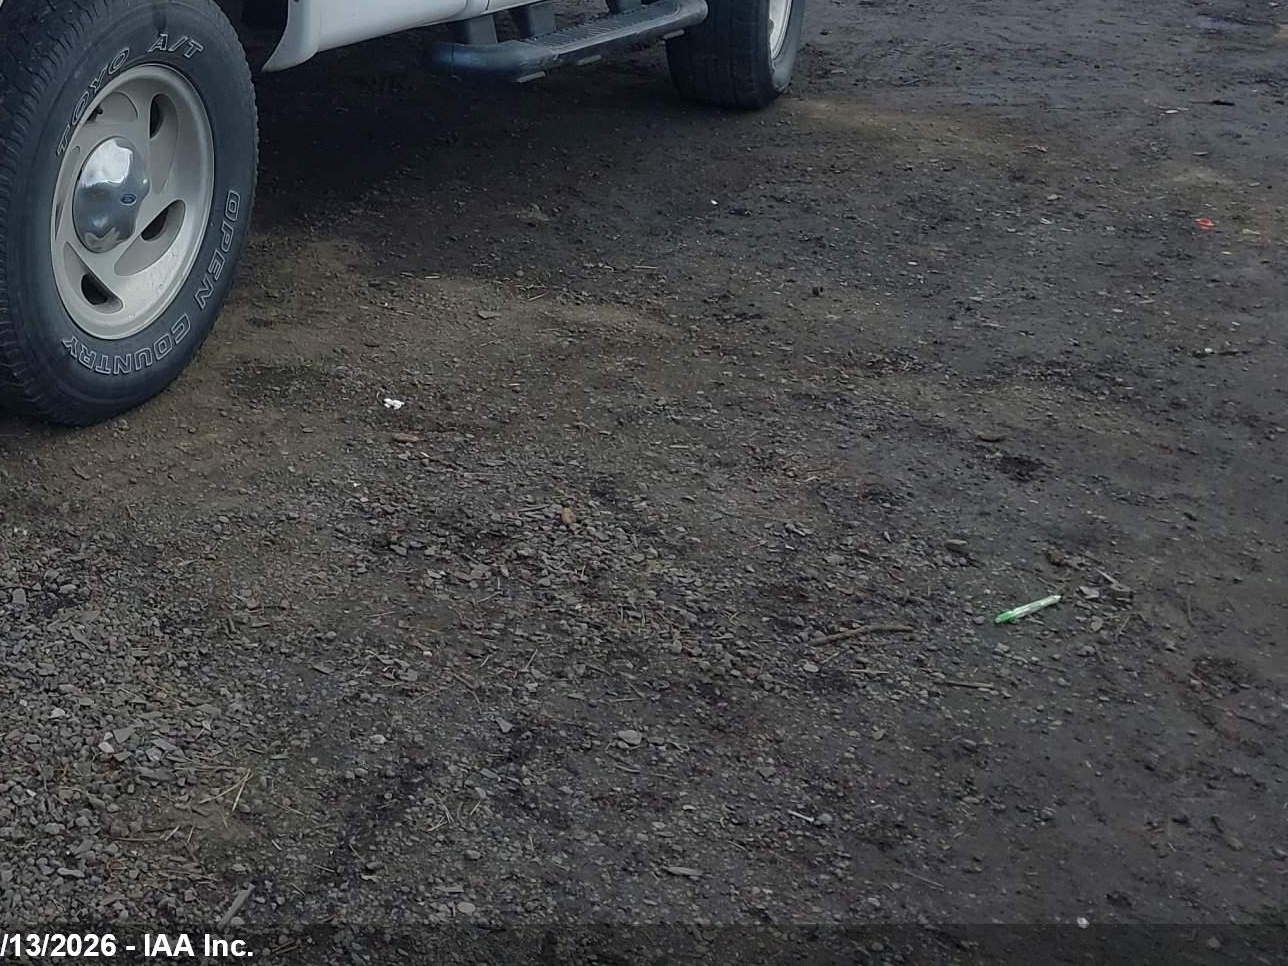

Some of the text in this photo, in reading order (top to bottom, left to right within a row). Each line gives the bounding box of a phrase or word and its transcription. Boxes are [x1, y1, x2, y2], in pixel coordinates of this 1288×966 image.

[56, 32, 205, 155] TOYO A/T
[62, 189, 241, 376] OPEN COUNTRY
